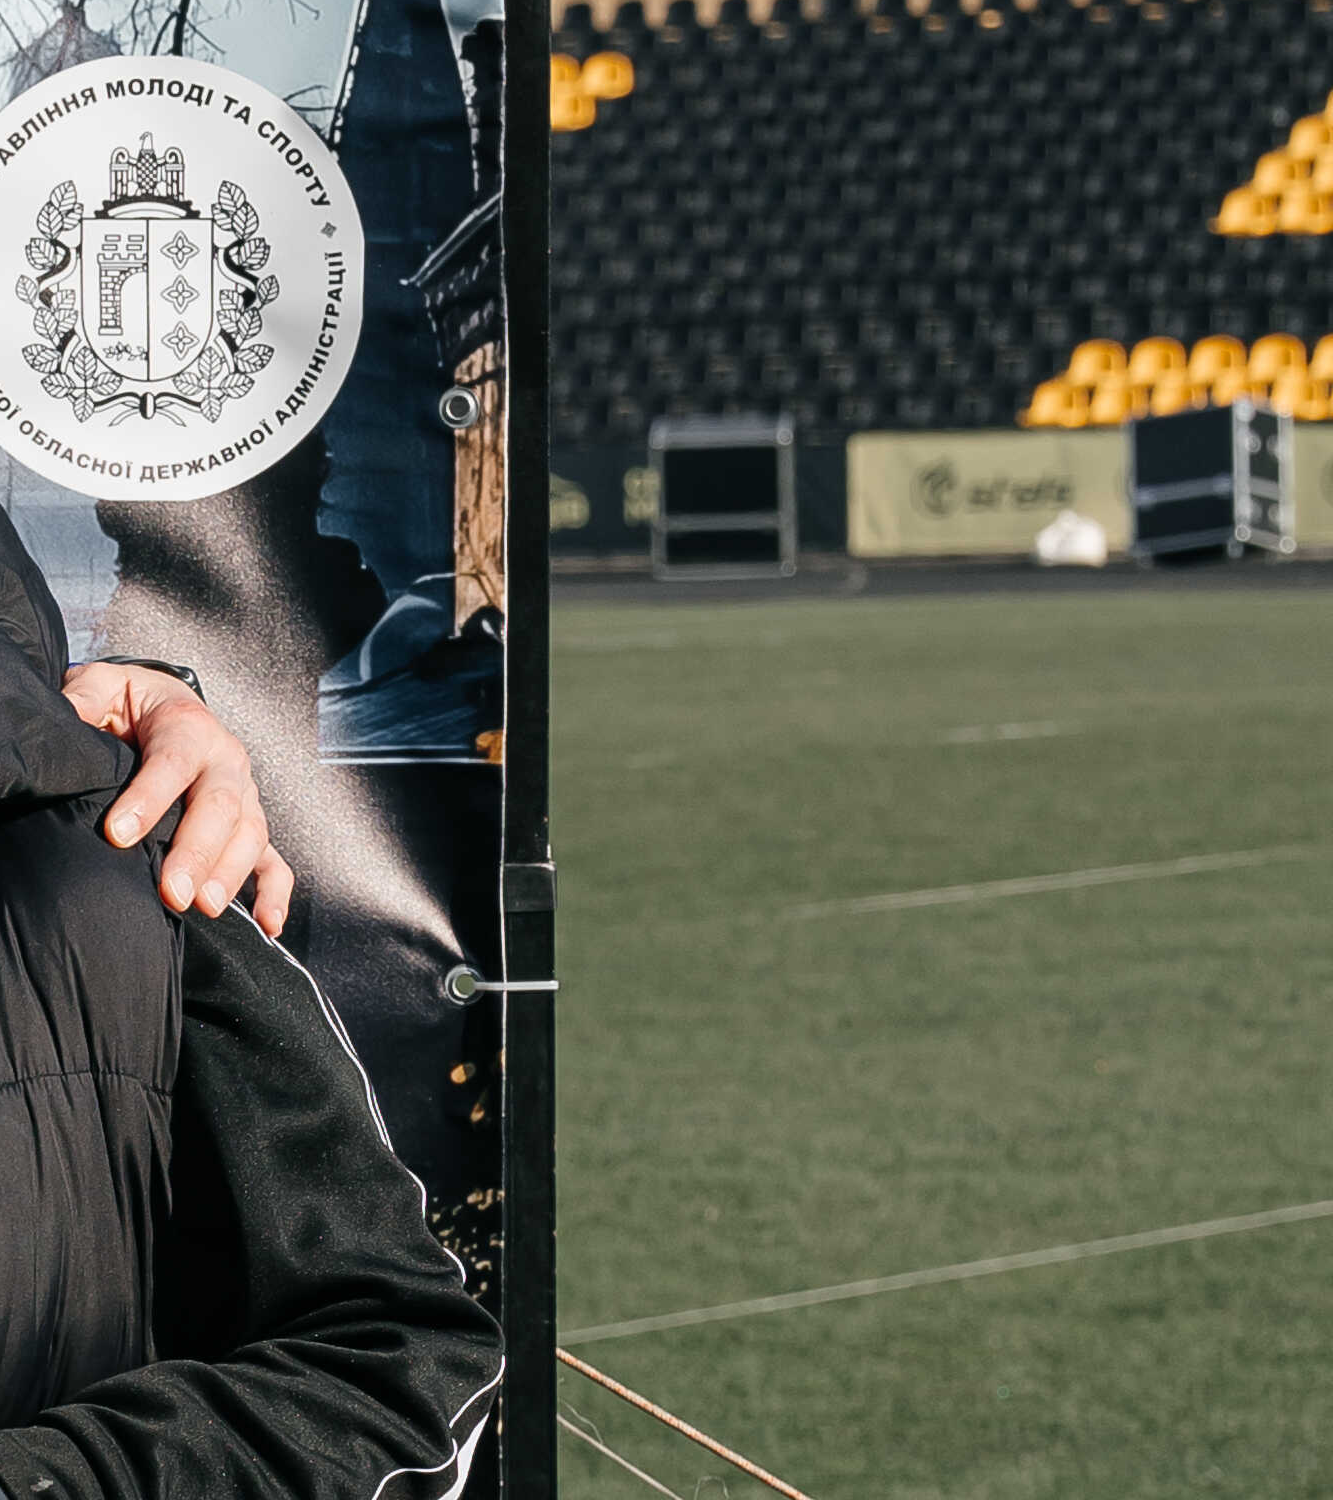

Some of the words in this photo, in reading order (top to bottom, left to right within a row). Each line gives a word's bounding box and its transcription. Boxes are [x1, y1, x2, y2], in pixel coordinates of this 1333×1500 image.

[106, 78, 214, 107] МОЛОДІ
[221, 95, 251, 125] ТА
[256, 120, 331, 207] СПОРТУ
[18, 420, 132, 479] ОБЛАСНОЇ
[139, 418, 274, 484] ДЕРЖАВНОЇ
[274, 251, 346, 427] АДМІНІСТРАЦІЇ
